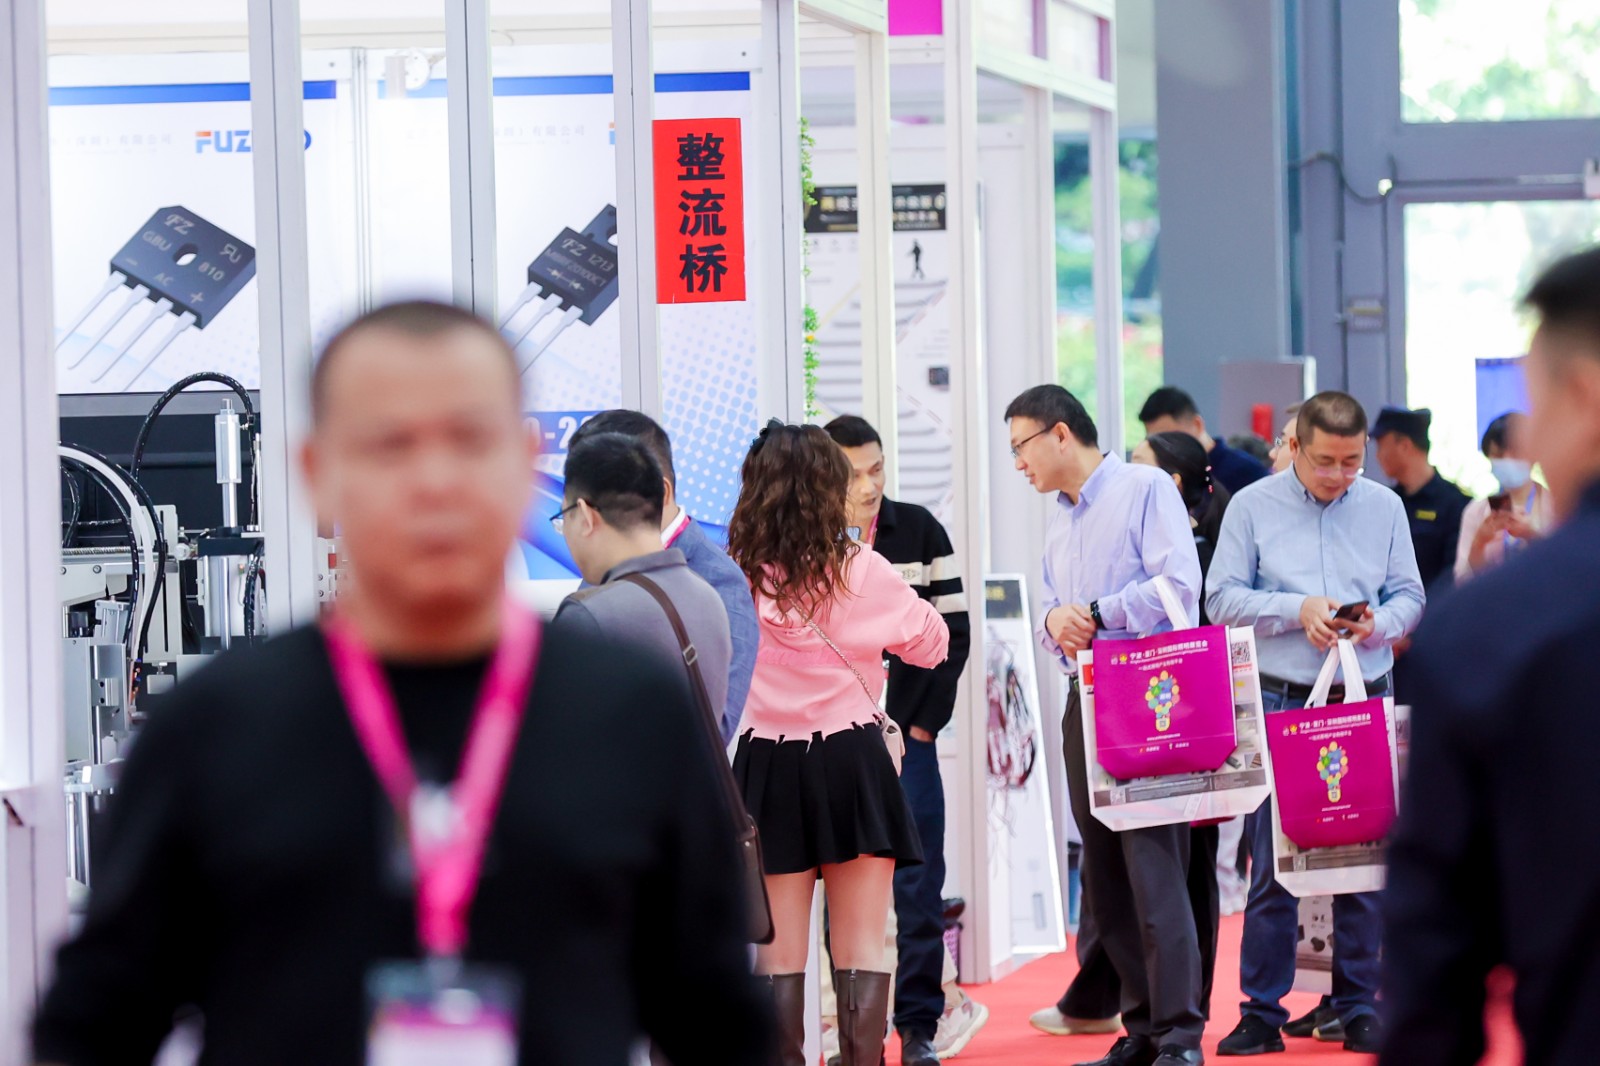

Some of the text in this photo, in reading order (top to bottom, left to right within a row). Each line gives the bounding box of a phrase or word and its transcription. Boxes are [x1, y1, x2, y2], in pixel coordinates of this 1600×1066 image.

[677, 132, 728, 293] 整流桥
[142, 230, 172, 251] GBU
[153, 272, 173, 286] AC
[198, 262, 224, 281] 810
